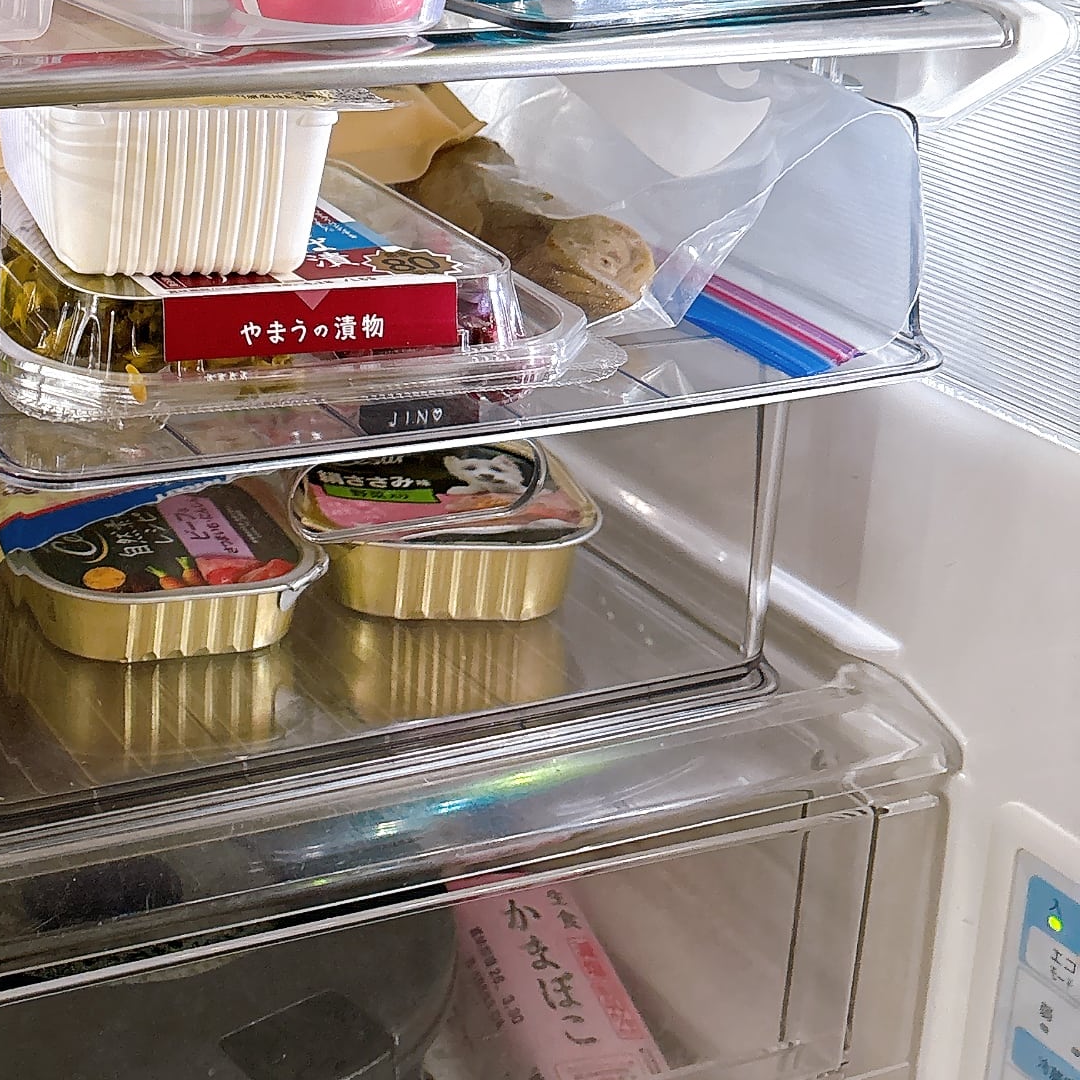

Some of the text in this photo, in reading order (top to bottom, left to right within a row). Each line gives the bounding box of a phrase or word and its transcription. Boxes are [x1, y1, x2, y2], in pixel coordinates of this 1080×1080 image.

[240, 313, 386, 346] やまうの漬物
